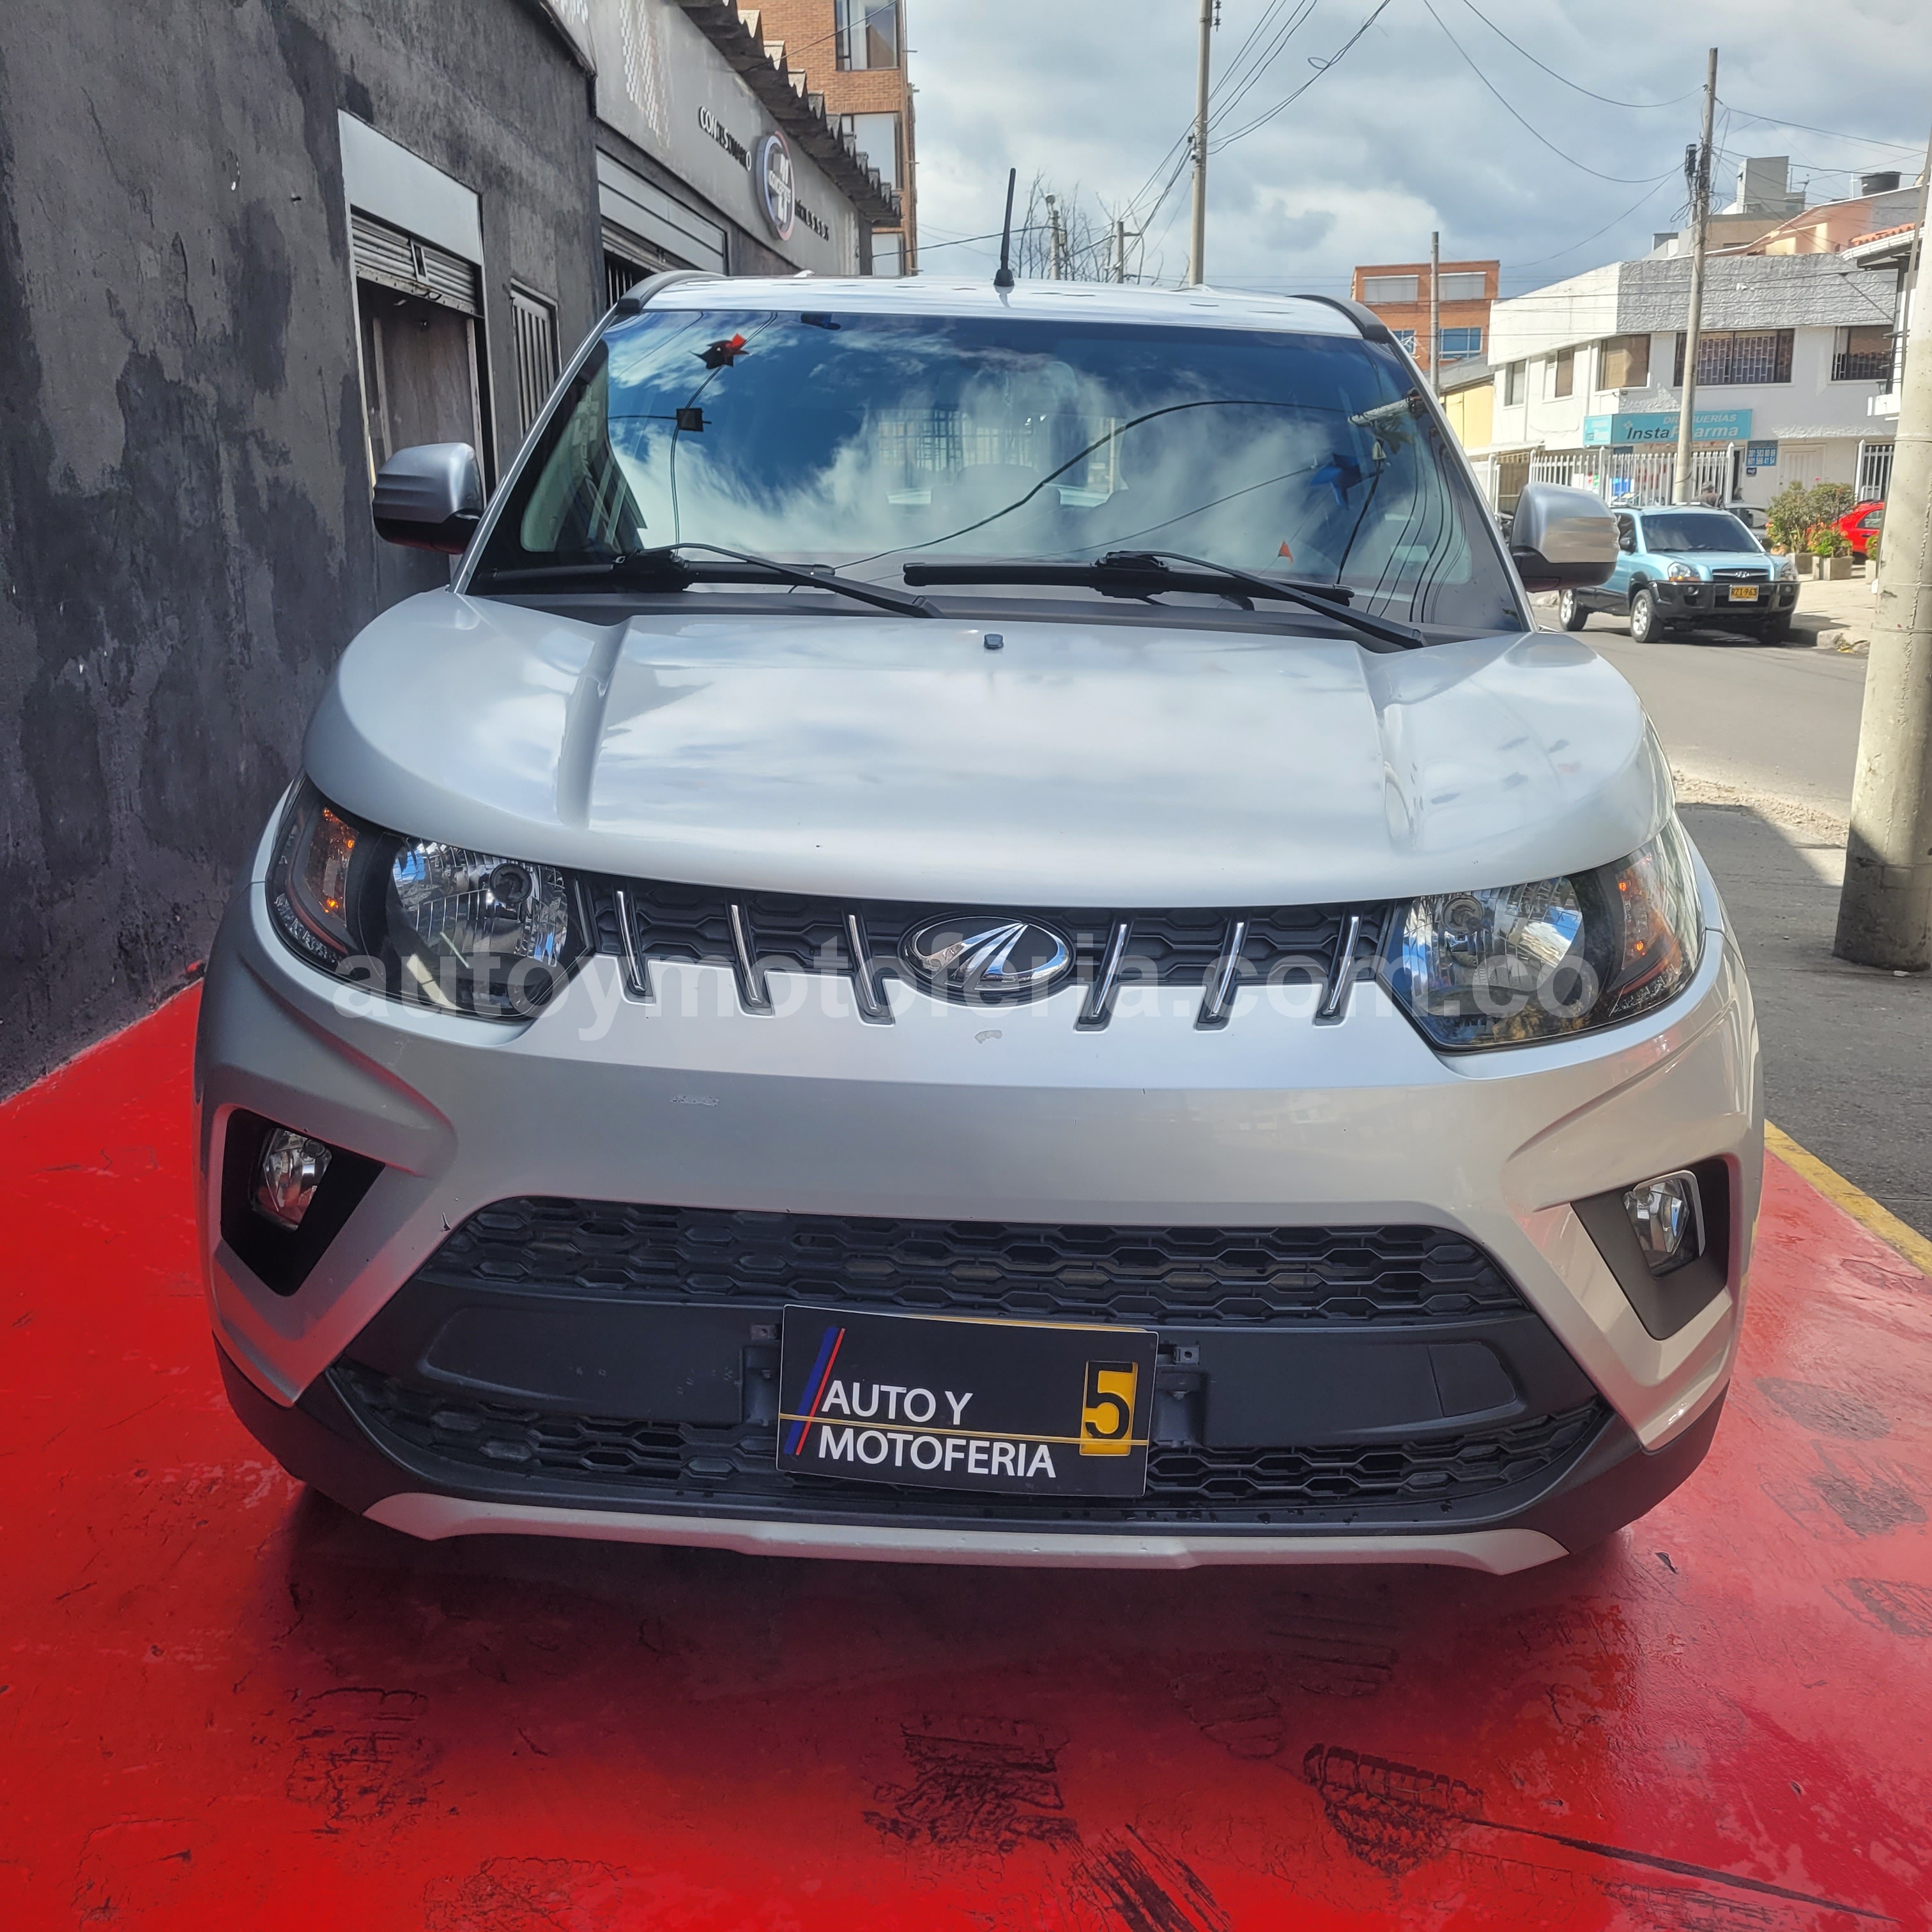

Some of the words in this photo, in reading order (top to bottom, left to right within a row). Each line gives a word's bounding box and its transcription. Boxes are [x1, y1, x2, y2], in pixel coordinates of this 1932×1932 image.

[1627, 426, 1738, 440] InstaParma
[1663, 413, 1737, 424] DRGUERÍAS
[821, 1380, 937, 1423] AUTO
[945, 1391, 974, 1425] Y
[818, 1425, 1057, 1478] MOTOFERIA
